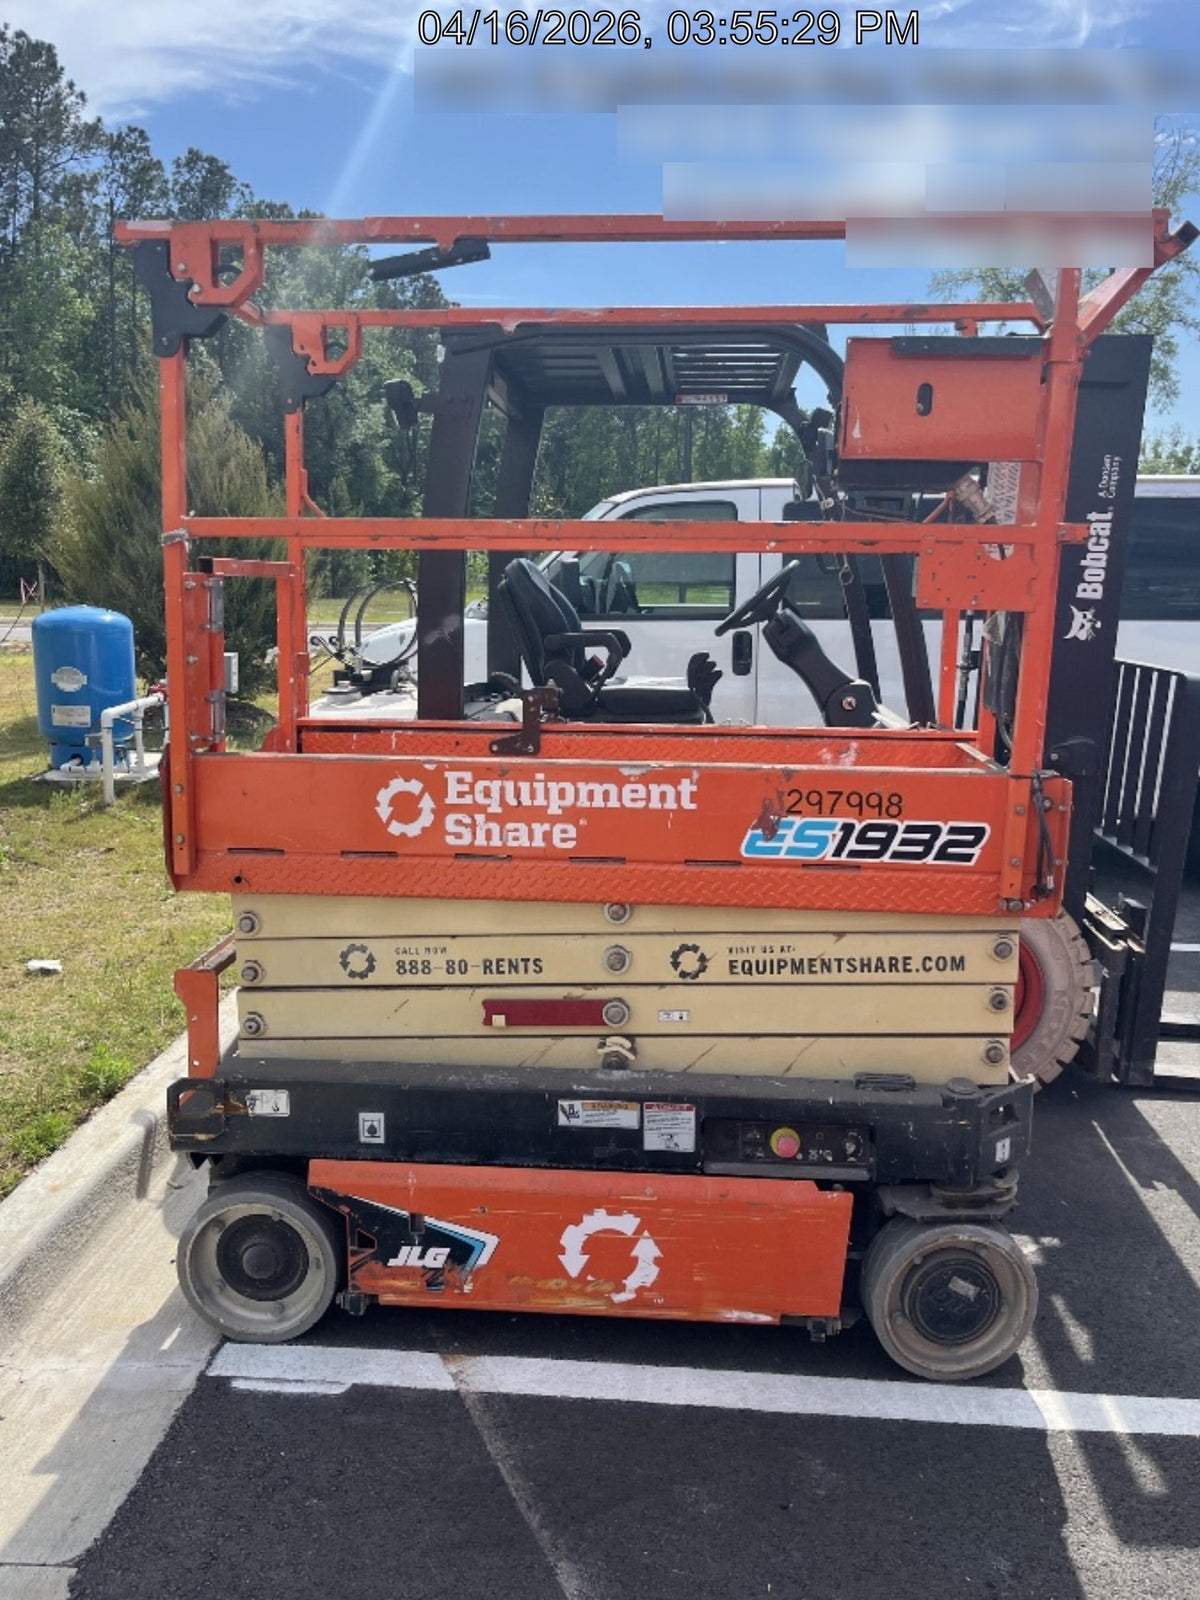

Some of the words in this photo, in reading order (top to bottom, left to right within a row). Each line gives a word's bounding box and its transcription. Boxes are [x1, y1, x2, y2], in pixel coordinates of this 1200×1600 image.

[1075, 511, 1113, 600] Bobcat
[444, 771, 698, 815] Equipment
[785, 789, 903, 818] 297998
[444, 813, 577, 849] Share
[742, 818, 989, 864] ES1932
[395, 947, 420, 955] CALL
[424, 946, 447, 954] NOW
[728, 945, 755, 954] VISIT
[761, 945, 774, 953] US
[395, 958, 543, 976] 888-80-RENTS
[728, 955, 965, 976] EQUIPMENTSHARE.COM
[387, 1245, 451, 1269] JLG
